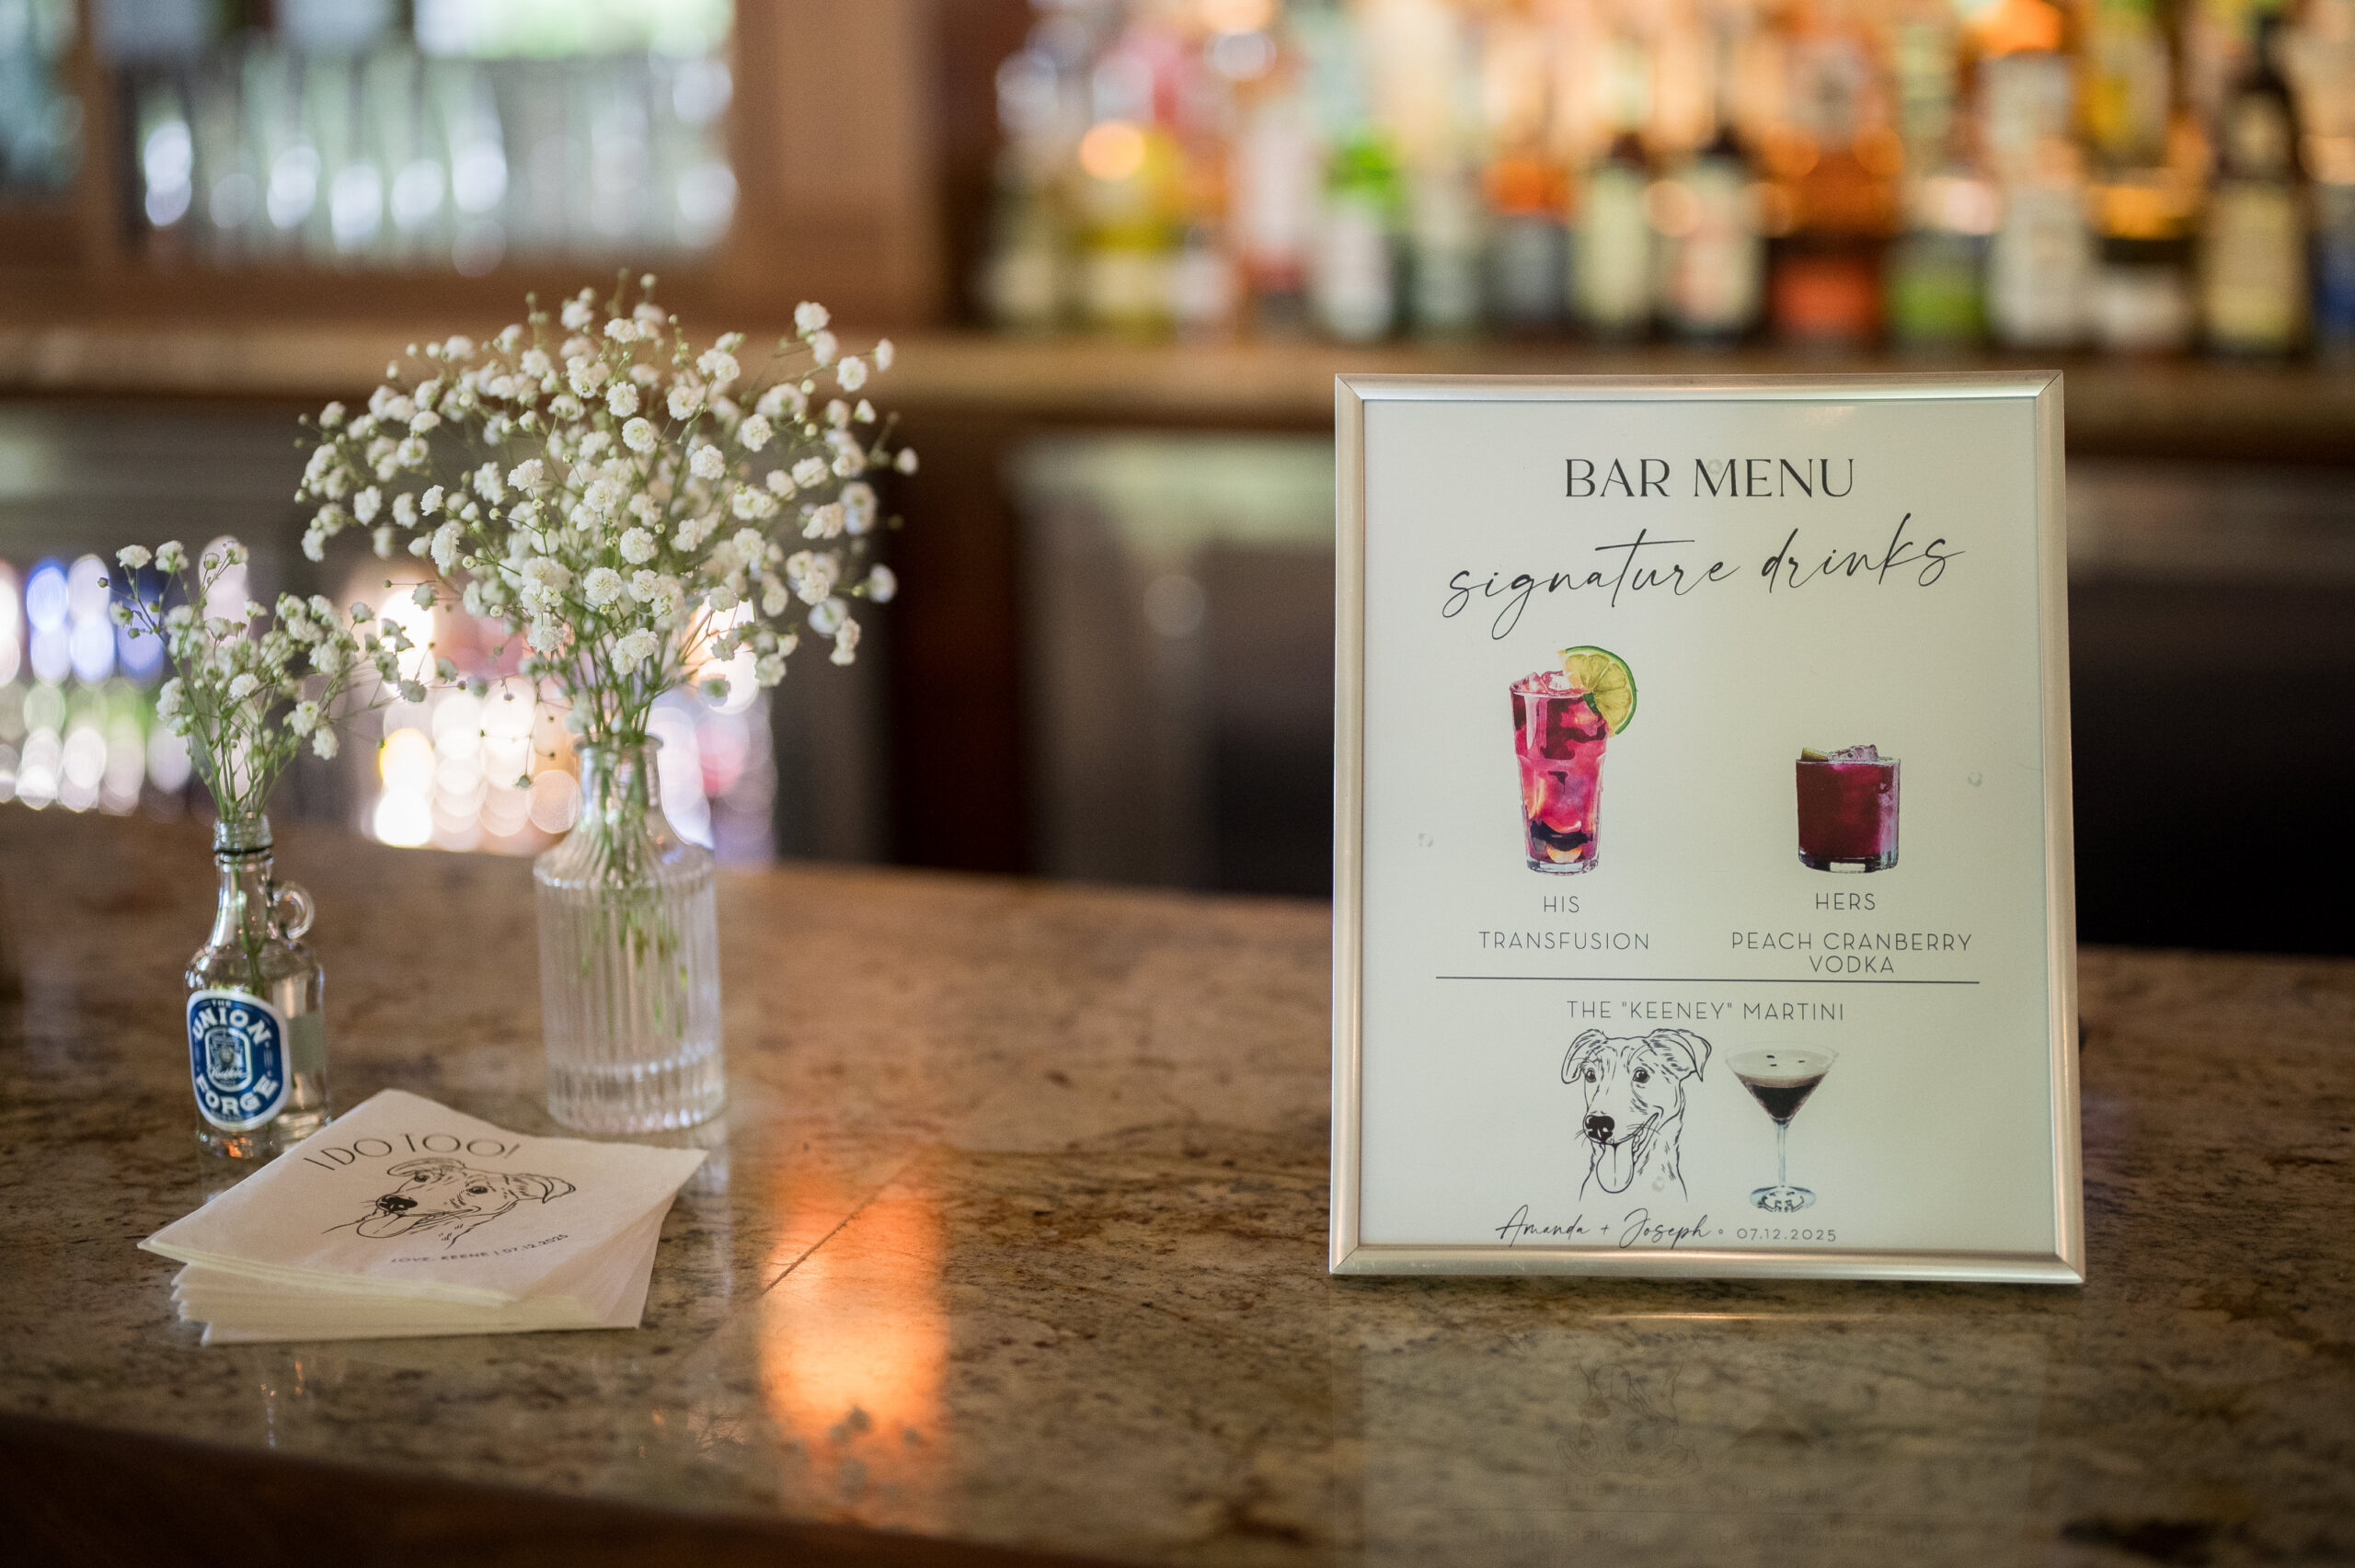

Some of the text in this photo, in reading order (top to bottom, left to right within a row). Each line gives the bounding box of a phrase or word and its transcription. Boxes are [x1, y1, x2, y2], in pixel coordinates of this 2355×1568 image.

[1565, 457, 1855, 498] BAR MENU
[1442, 512, 1966, 640] signature drinks
[1544, 895, 1580, 913] HIS
[1815, 892, 1876, 911] HERS
[1478, 931, 1649, 950] TRANSFUSION
[1731, 931, 1972, 951] PEACH CRANBERRY
[1809, 955, 1896, 974] VODKA
[1566, 1001, 1844, 1021] THE "KEENEY" MARTINI
[191, 1006, 273, 1046] UNION
[196, 1073, 279, 1116] FORGE
[319, 1138, 394, 1166] DO
[303, 1157, 336, 1172] I
[1495, 1204, 1590, 1248] Amanda
[1618, 1207, 1712, 1250] Joseph
[1736, 1227, 1837, 1242] 07.12.2025
[501, 1233, 569, 1254] 07.12.2025
